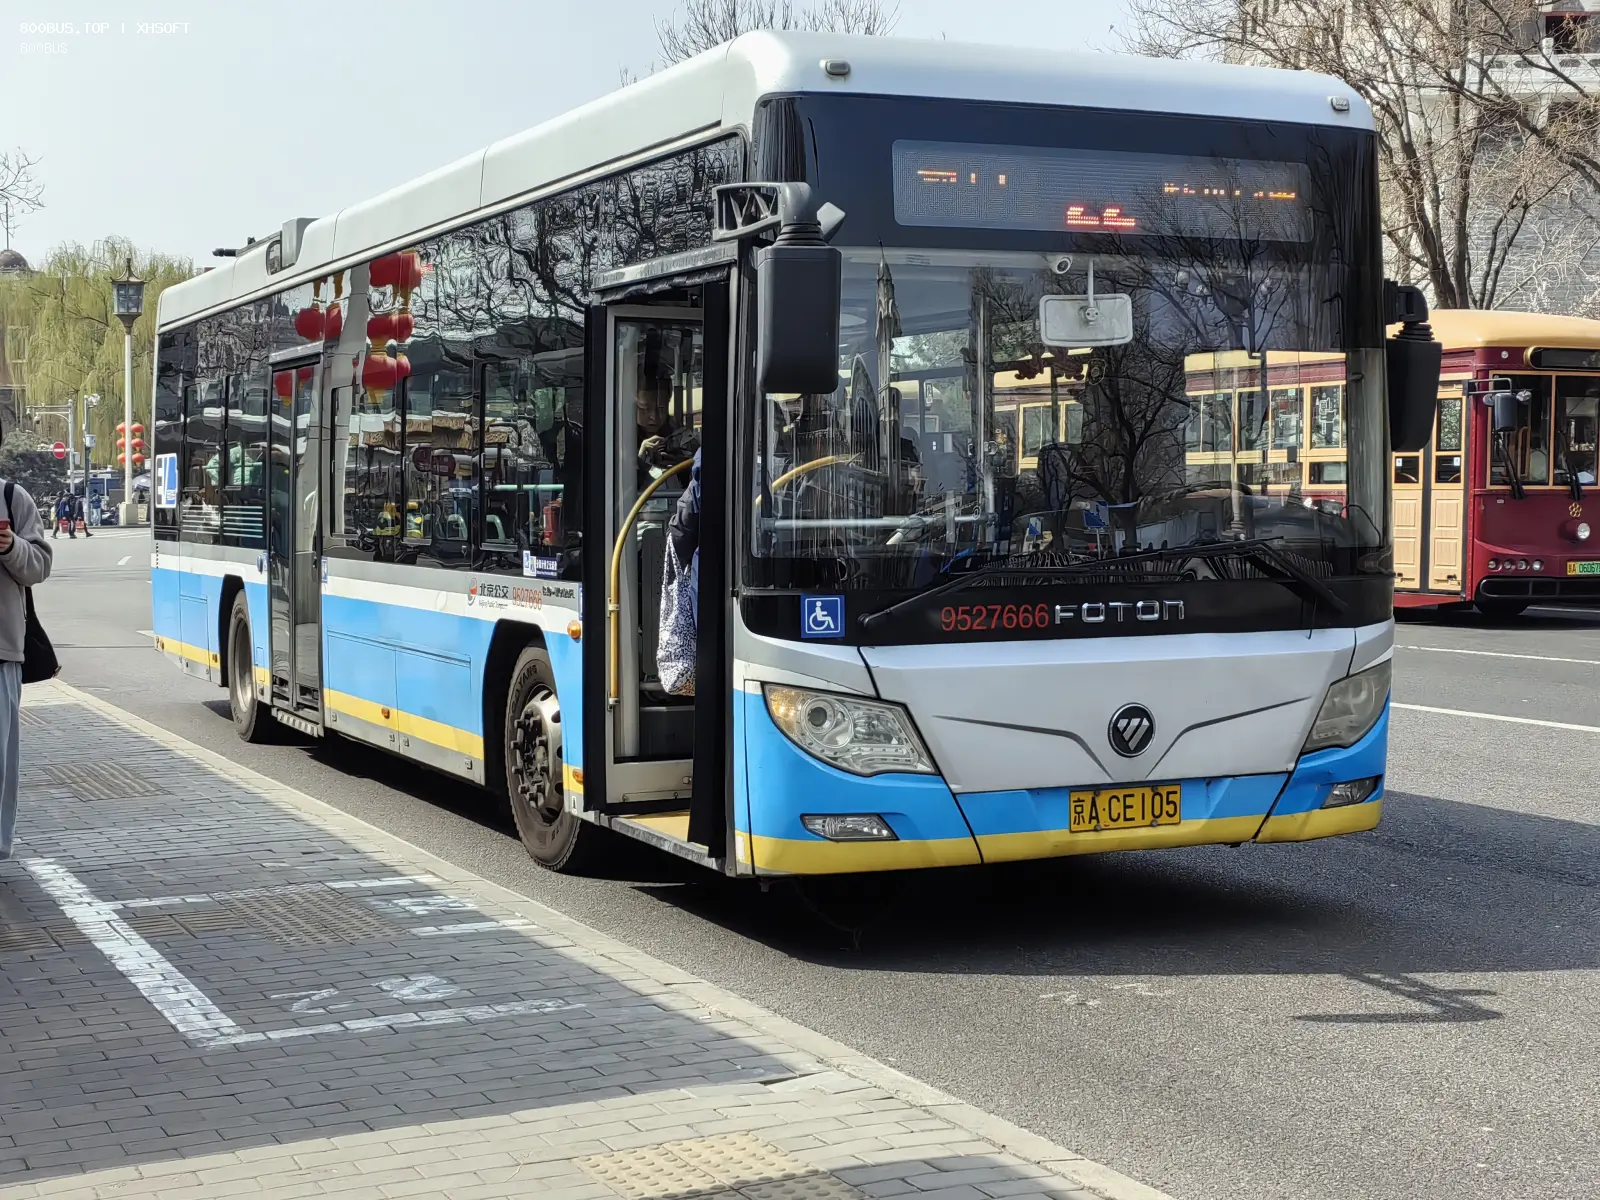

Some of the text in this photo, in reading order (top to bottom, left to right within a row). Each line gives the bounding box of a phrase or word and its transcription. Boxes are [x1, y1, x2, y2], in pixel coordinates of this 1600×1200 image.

[479, 582, 510, 600] 北京公交
[941, 603, 1049, 632] 9527666
[1054, 599, 1185, 625] FOTON
